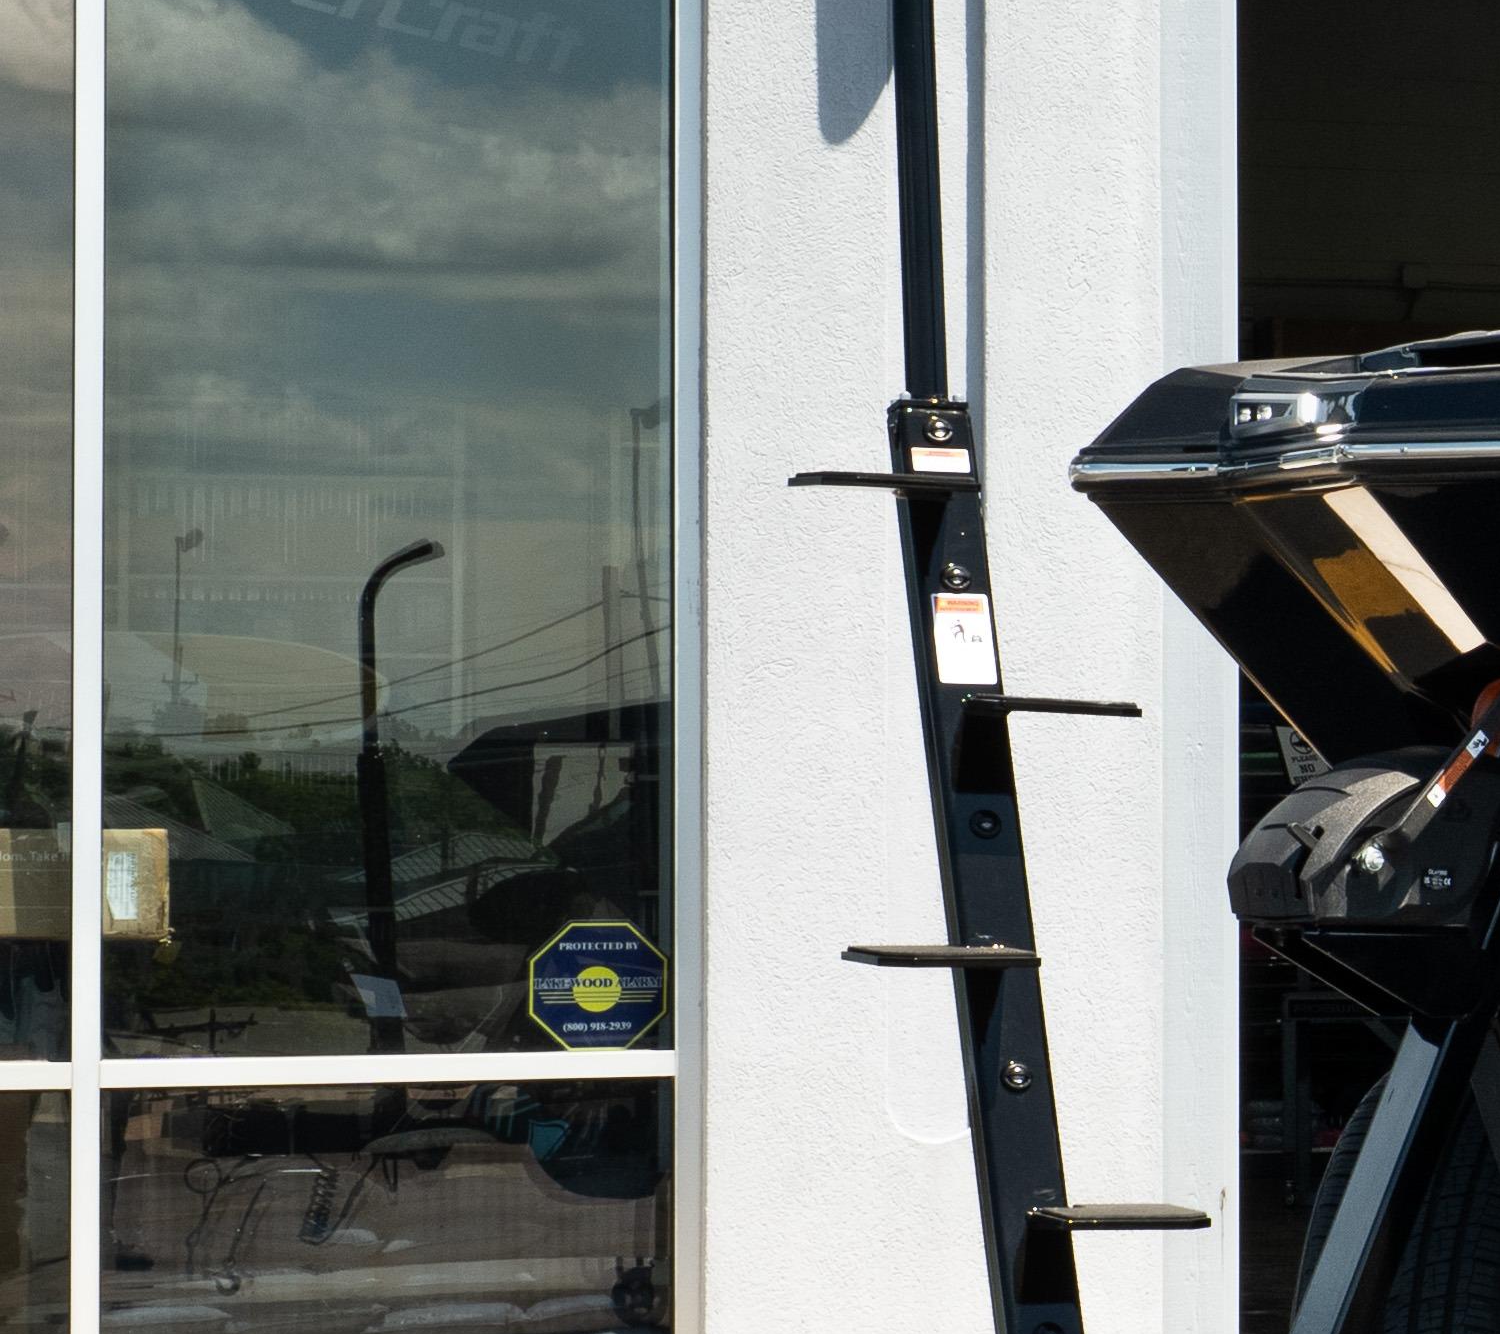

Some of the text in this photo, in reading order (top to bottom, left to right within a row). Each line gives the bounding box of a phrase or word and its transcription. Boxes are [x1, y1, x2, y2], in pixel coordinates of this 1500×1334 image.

[559, 942, 639, 951] PROTECTED BY
[534, 976, 662, 989] LAKEWOOD ALARM
[563, 1021, 632, 1032] (800) 918-2939
